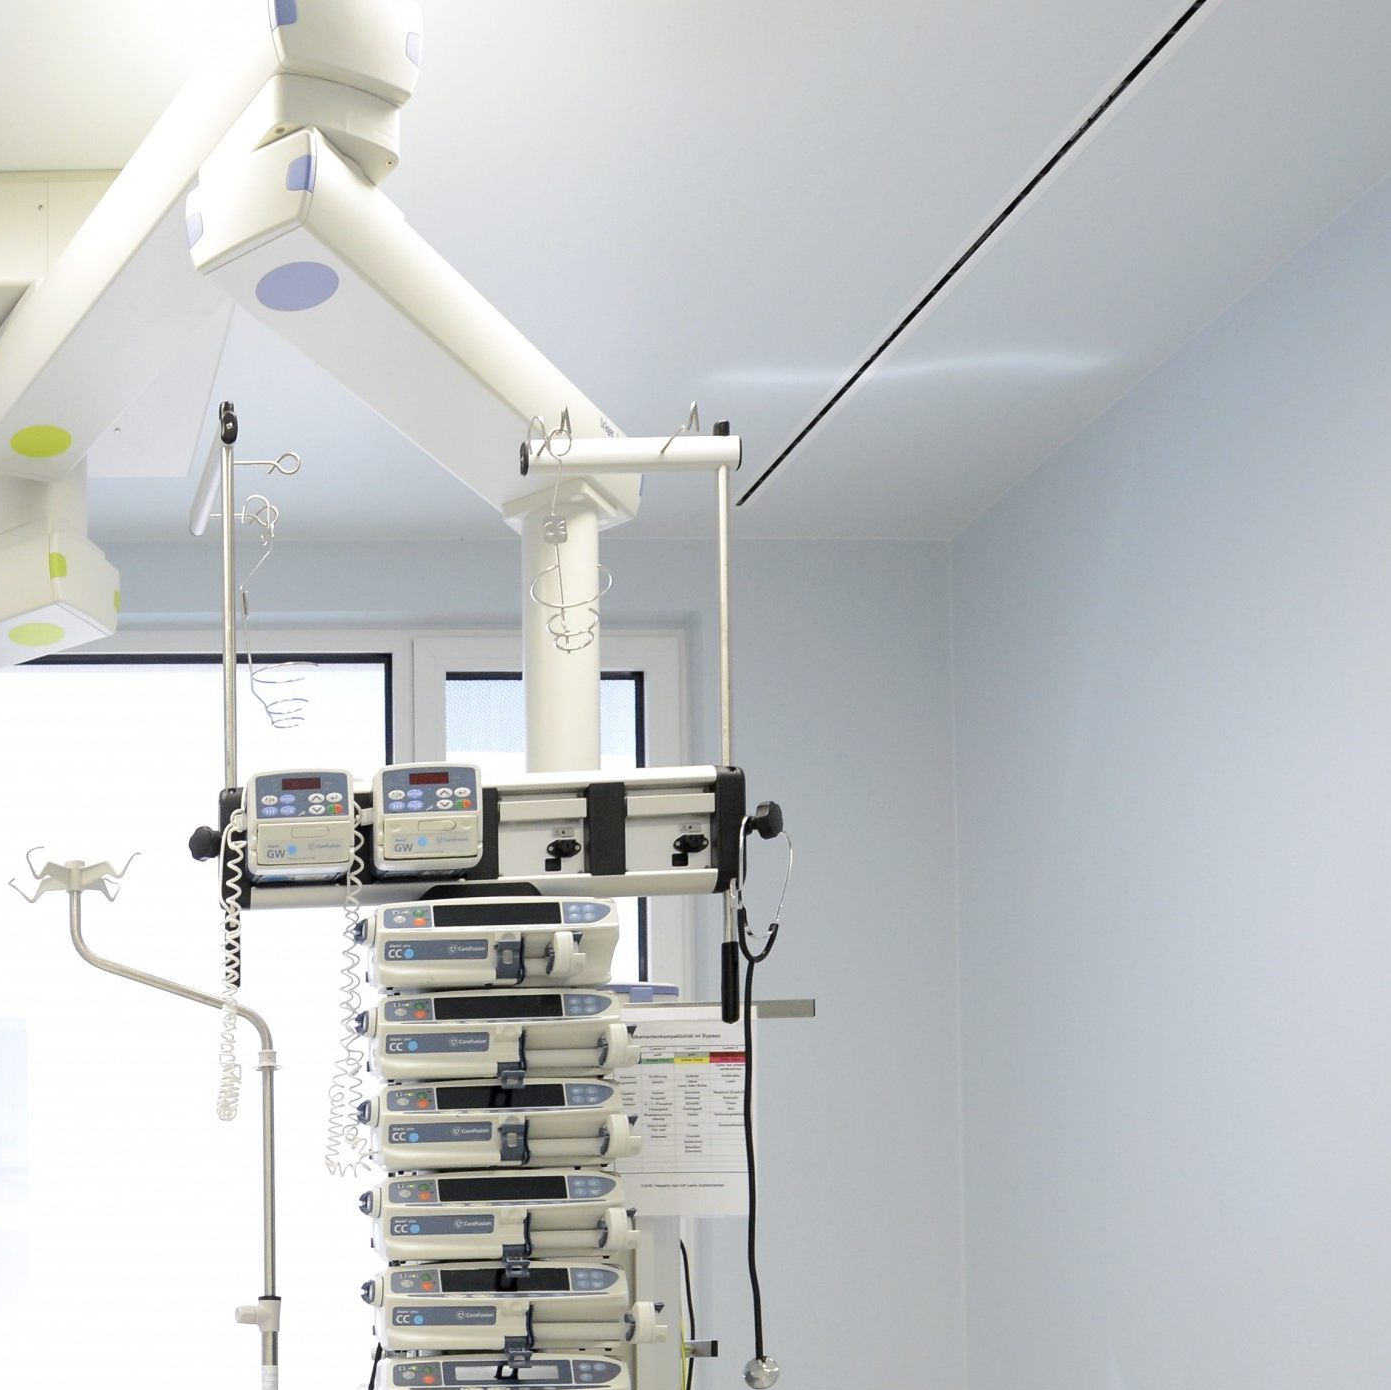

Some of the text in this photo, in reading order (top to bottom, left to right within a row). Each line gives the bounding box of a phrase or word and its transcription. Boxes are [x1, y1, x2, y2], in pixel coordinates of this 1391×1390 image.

[394, 843, 413, 852] GW
[267, 849, 286, 858] GW
[388, 949, 402, 958] CC
[389, 1042, 403, 1051] CC
[392, 1132, 406, 1141] CC
[394, 1224, 408, 1233] CC
[396, 1314, 410, 1324] CC
